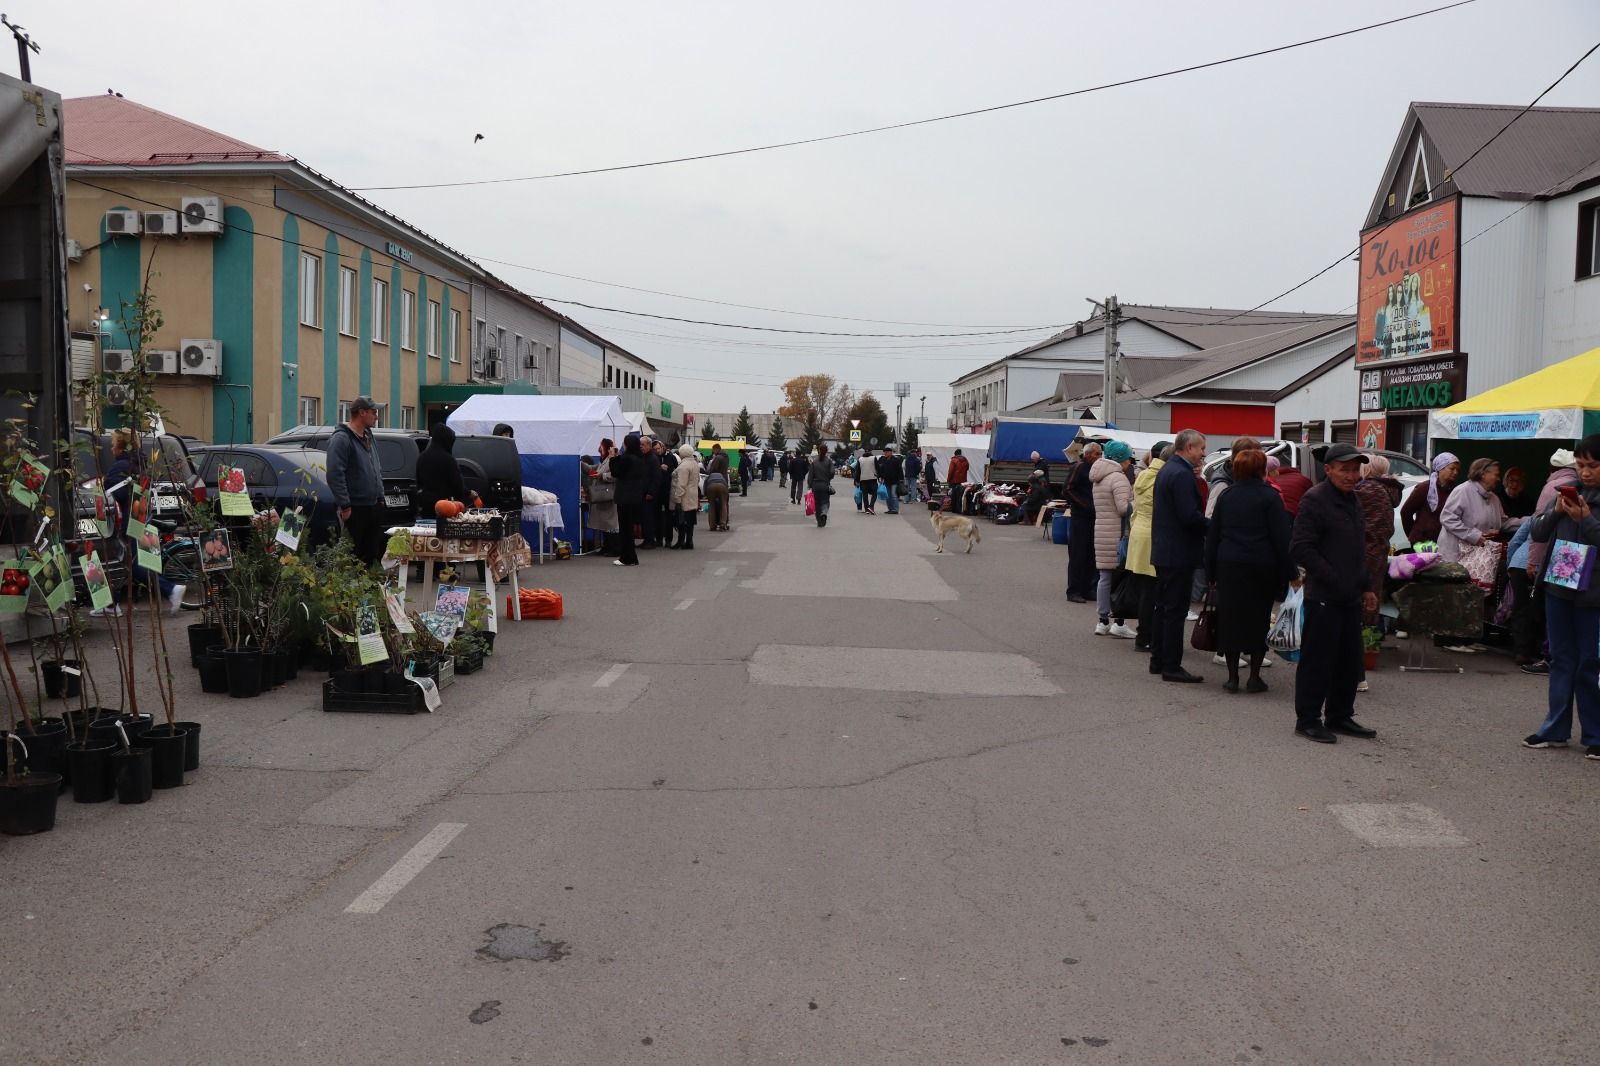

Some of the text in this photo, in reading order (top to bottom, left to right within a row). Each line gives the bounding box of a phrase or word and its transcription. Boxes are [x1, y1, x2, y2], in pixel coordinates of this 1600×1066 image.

[1366, 236, 1440, 279] Колос
[1389, 371, 1443, 385] МАГАЗИН ХОЗТОВАРОВ
[1381, 382, 1451, 408] МЕГАХОЗ
[1459, 421, 1510, 433] БЛАГОТВОРИТЕЛЬНАЯ
